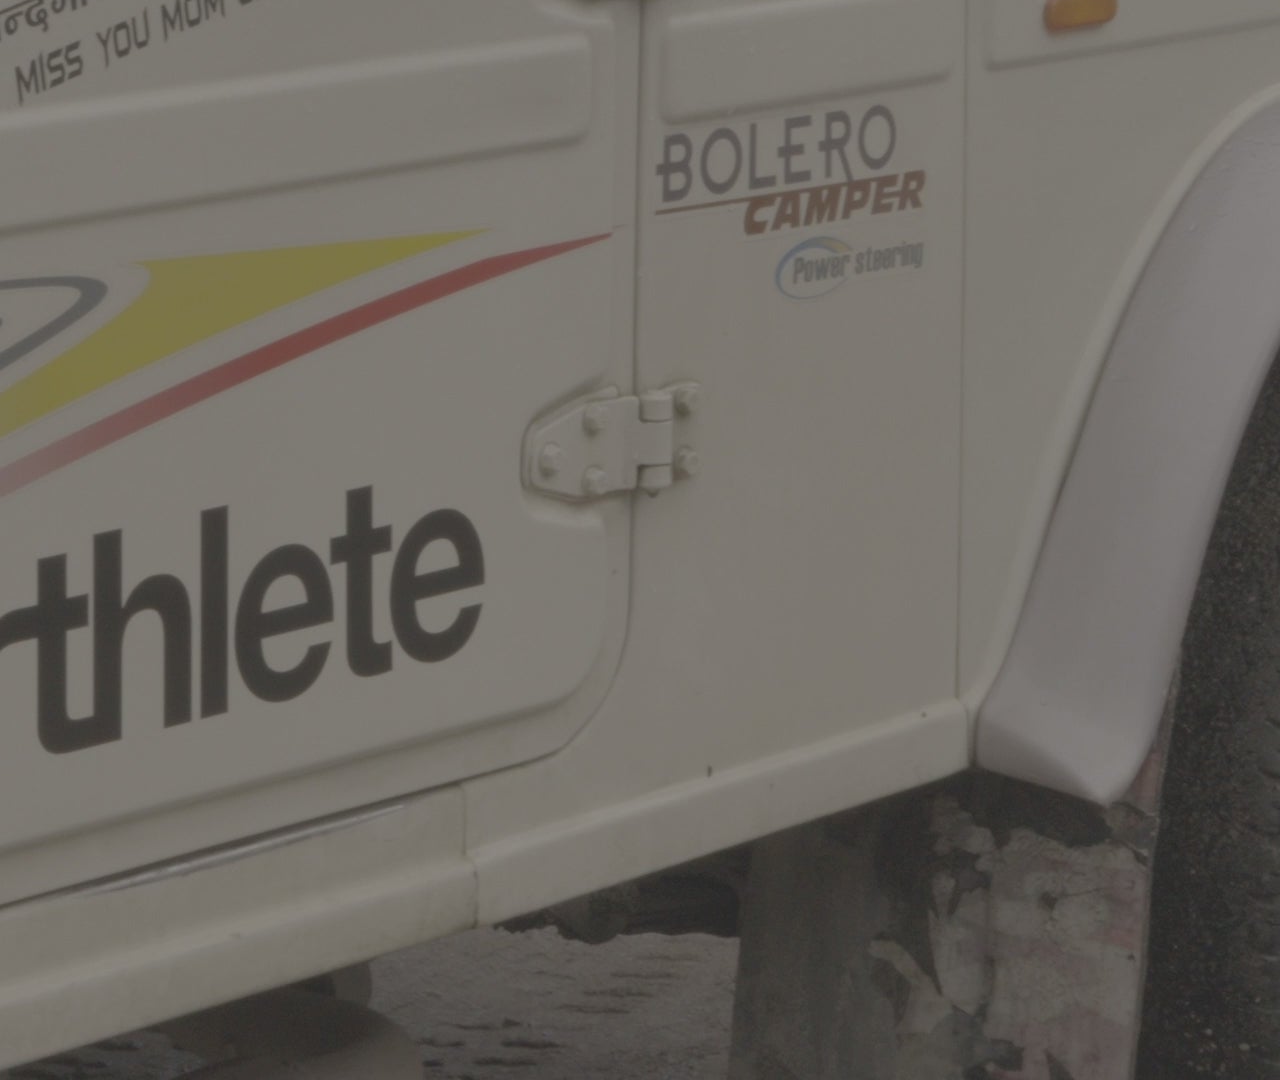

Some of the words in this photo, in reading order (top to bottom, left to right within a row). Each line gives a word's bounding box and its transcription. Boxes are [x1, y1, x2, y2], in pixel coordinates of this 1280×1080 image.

[15, 41, 83, 105] MISS
[96, 10, 149, 66] YOU
[656, 104, 897, 203] BOLERO
[743, 170, 927, 236] CAMPER
[792, 252, 850, 284] Power
[854, 240, 924, 275] steering
